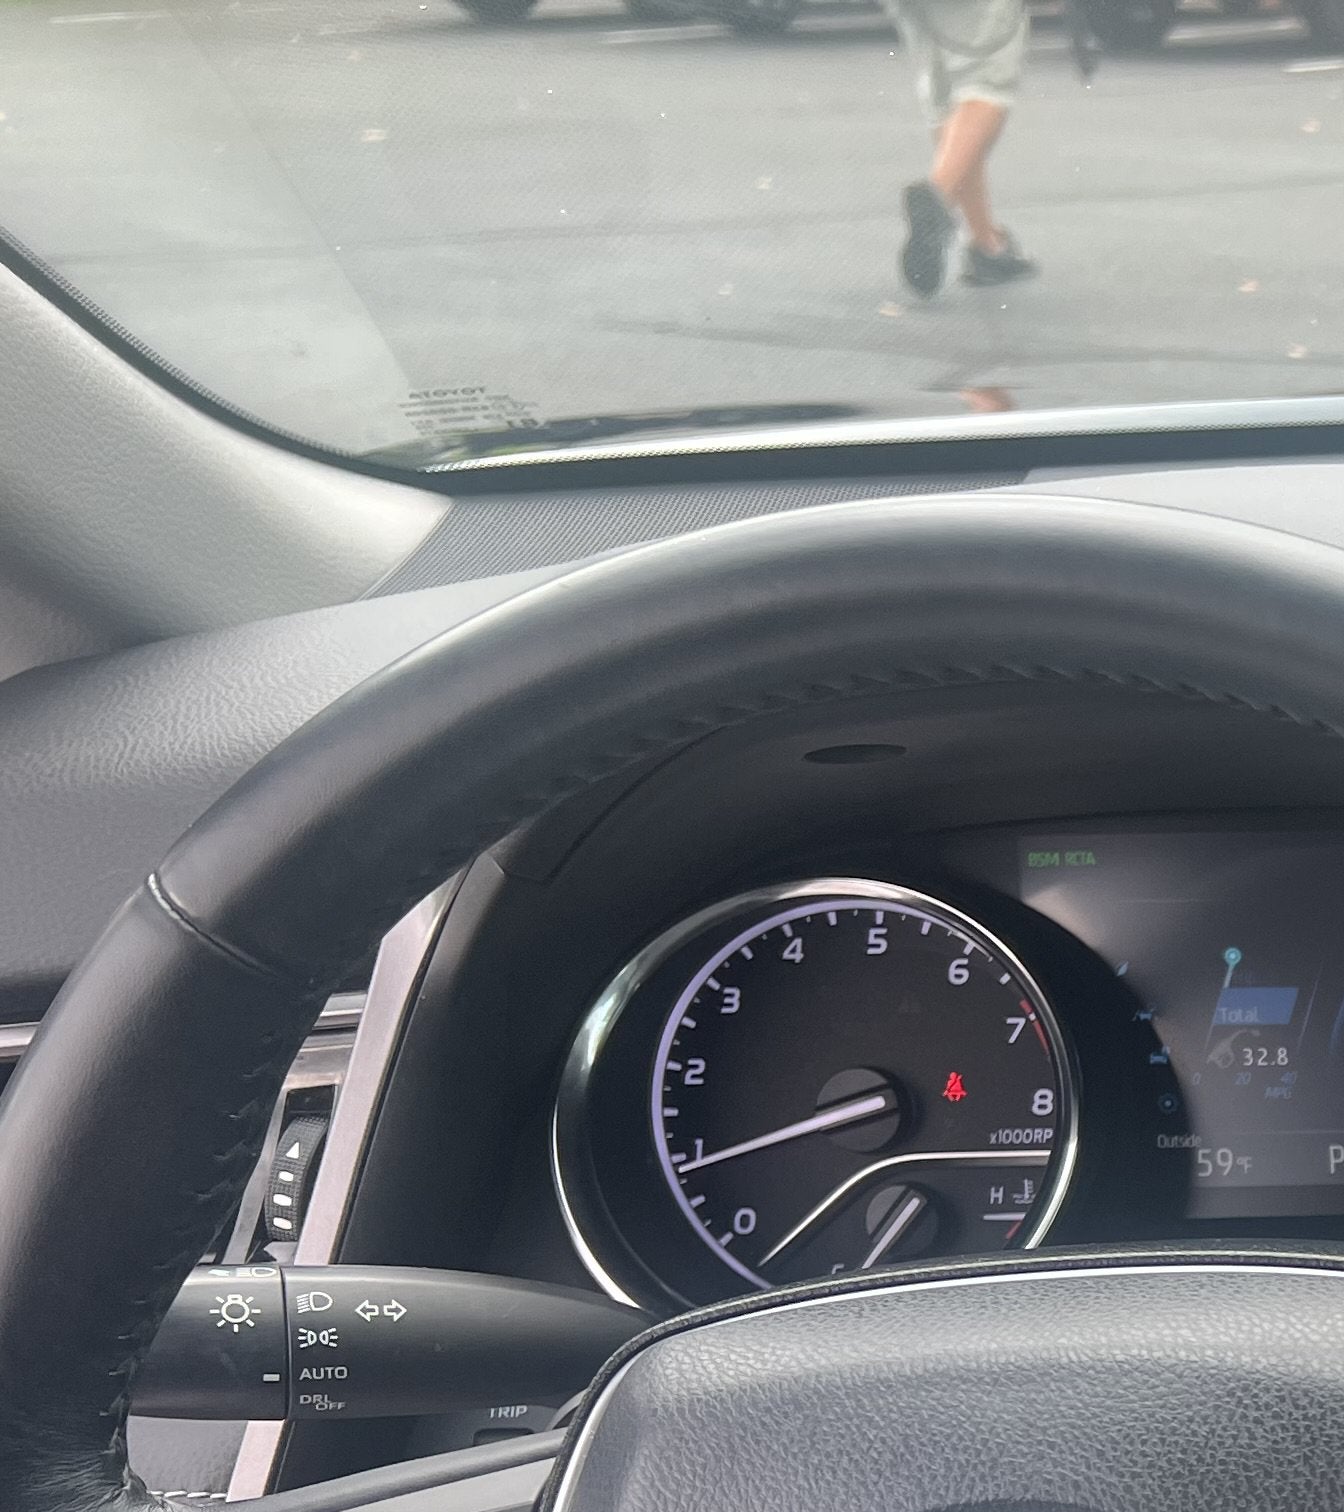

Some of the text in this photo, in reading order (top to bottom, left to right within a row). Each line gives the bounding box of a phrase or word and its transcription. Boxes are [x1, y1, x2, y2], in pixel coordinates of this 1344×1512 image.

[782, 938, 804, 963] 4
[866, 928, 888, 955] 5
[948, 958, 969, 984] 6
[720, 987, 741, 1014] 3
[1219, 1007, 1260, 1023] Total
[1006, 1017, 1026, 1043] 7
[1242, 1047, 1289, 1066] 32.8
[684, 1059, 705, 1085] 2
[1032, 1088, 1054, 1115] 8
[1157, 1134, 1202, 1149] Outside
[1329, 1144, 1344, 1174] P
[990, 1186, 1003, 1204] H
[734, 1208, 756, 1235] 0
[299, 1366, 348, 1381] AUTO
[299, 1394, 331, 1405] DRL
[315, 1401, 346, 1411] OFF
